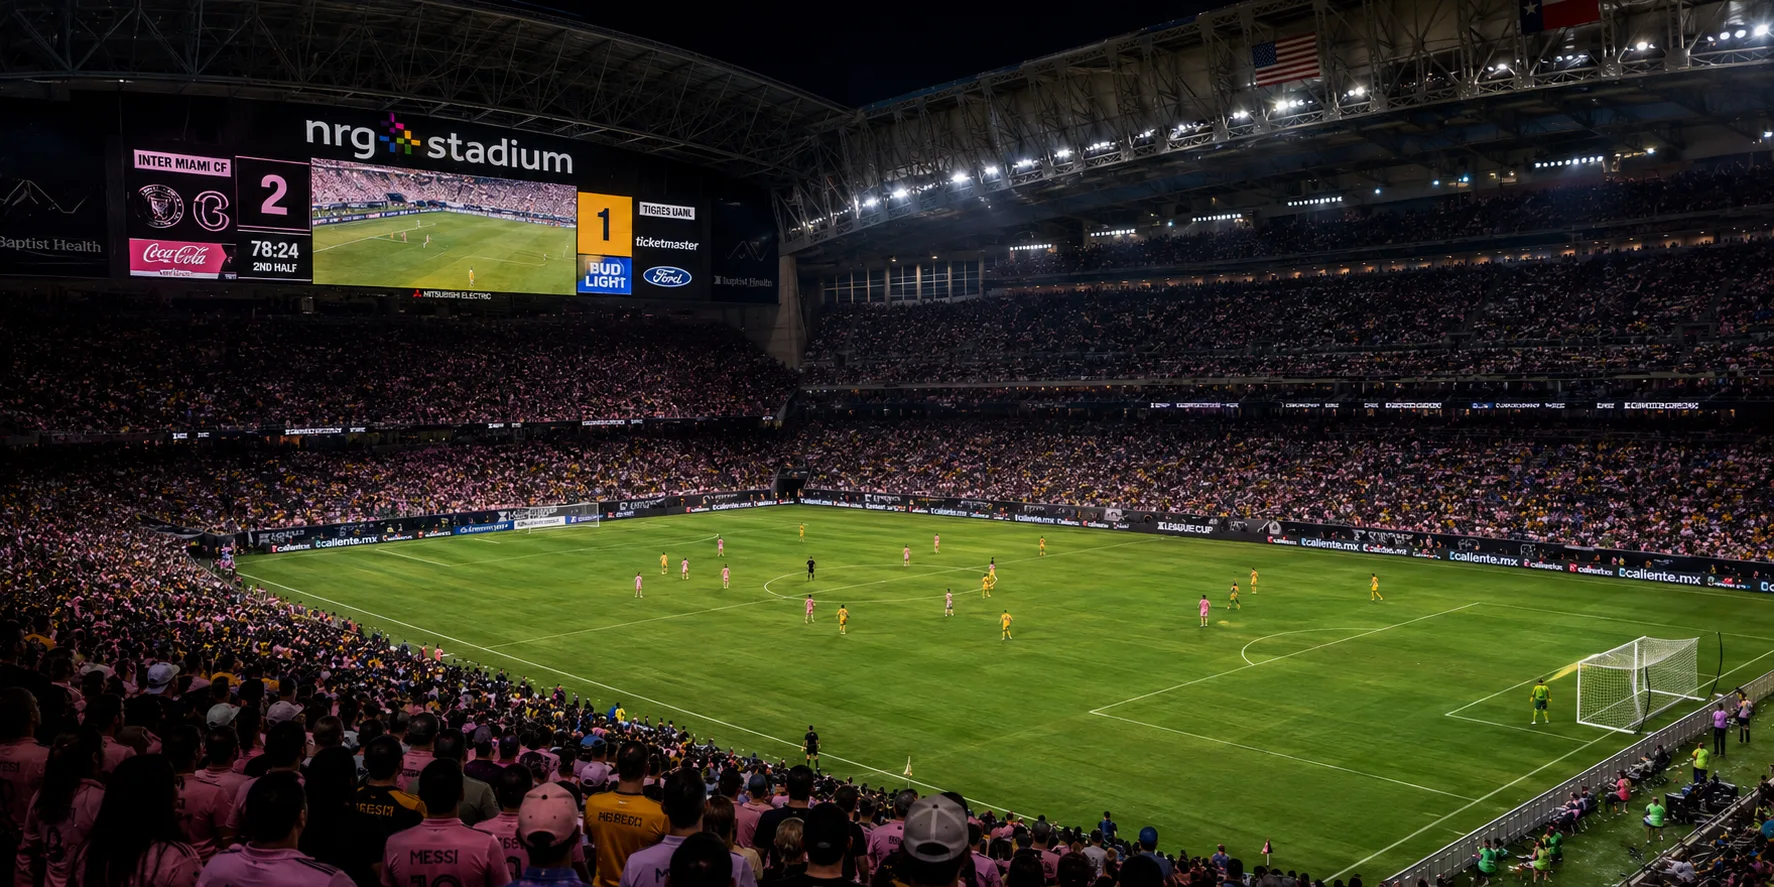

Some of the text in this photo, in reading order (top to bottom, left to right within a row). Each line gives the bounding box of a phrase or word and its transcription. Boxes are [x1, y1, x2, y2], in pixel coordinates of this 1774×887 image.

[306, 120, 573, 174] nrg stadium
[138, 154, 227, 173] INTER MIAMI CF
[261, 174, 288, 216] 2
[643, 204, 671, 216] TIGRES
[597, 208, 610, 241] 1
[52, 238, 102, 253] Health
[251, 240, 299, 259] 78:24
[635, 236, 699, 251] ticketmaster
[253, 262, 297, 273] 2ND HALF
[590, 262, 621, 276] BUD
[585, 276, 627, 289] LIGHT
[652, 269, 683, 284] Ford
[461, 292, 492, 300] ELECTRIC
[1195, 525, 1214, 534] CUP
[410, 849, 459, 865] MESSI
